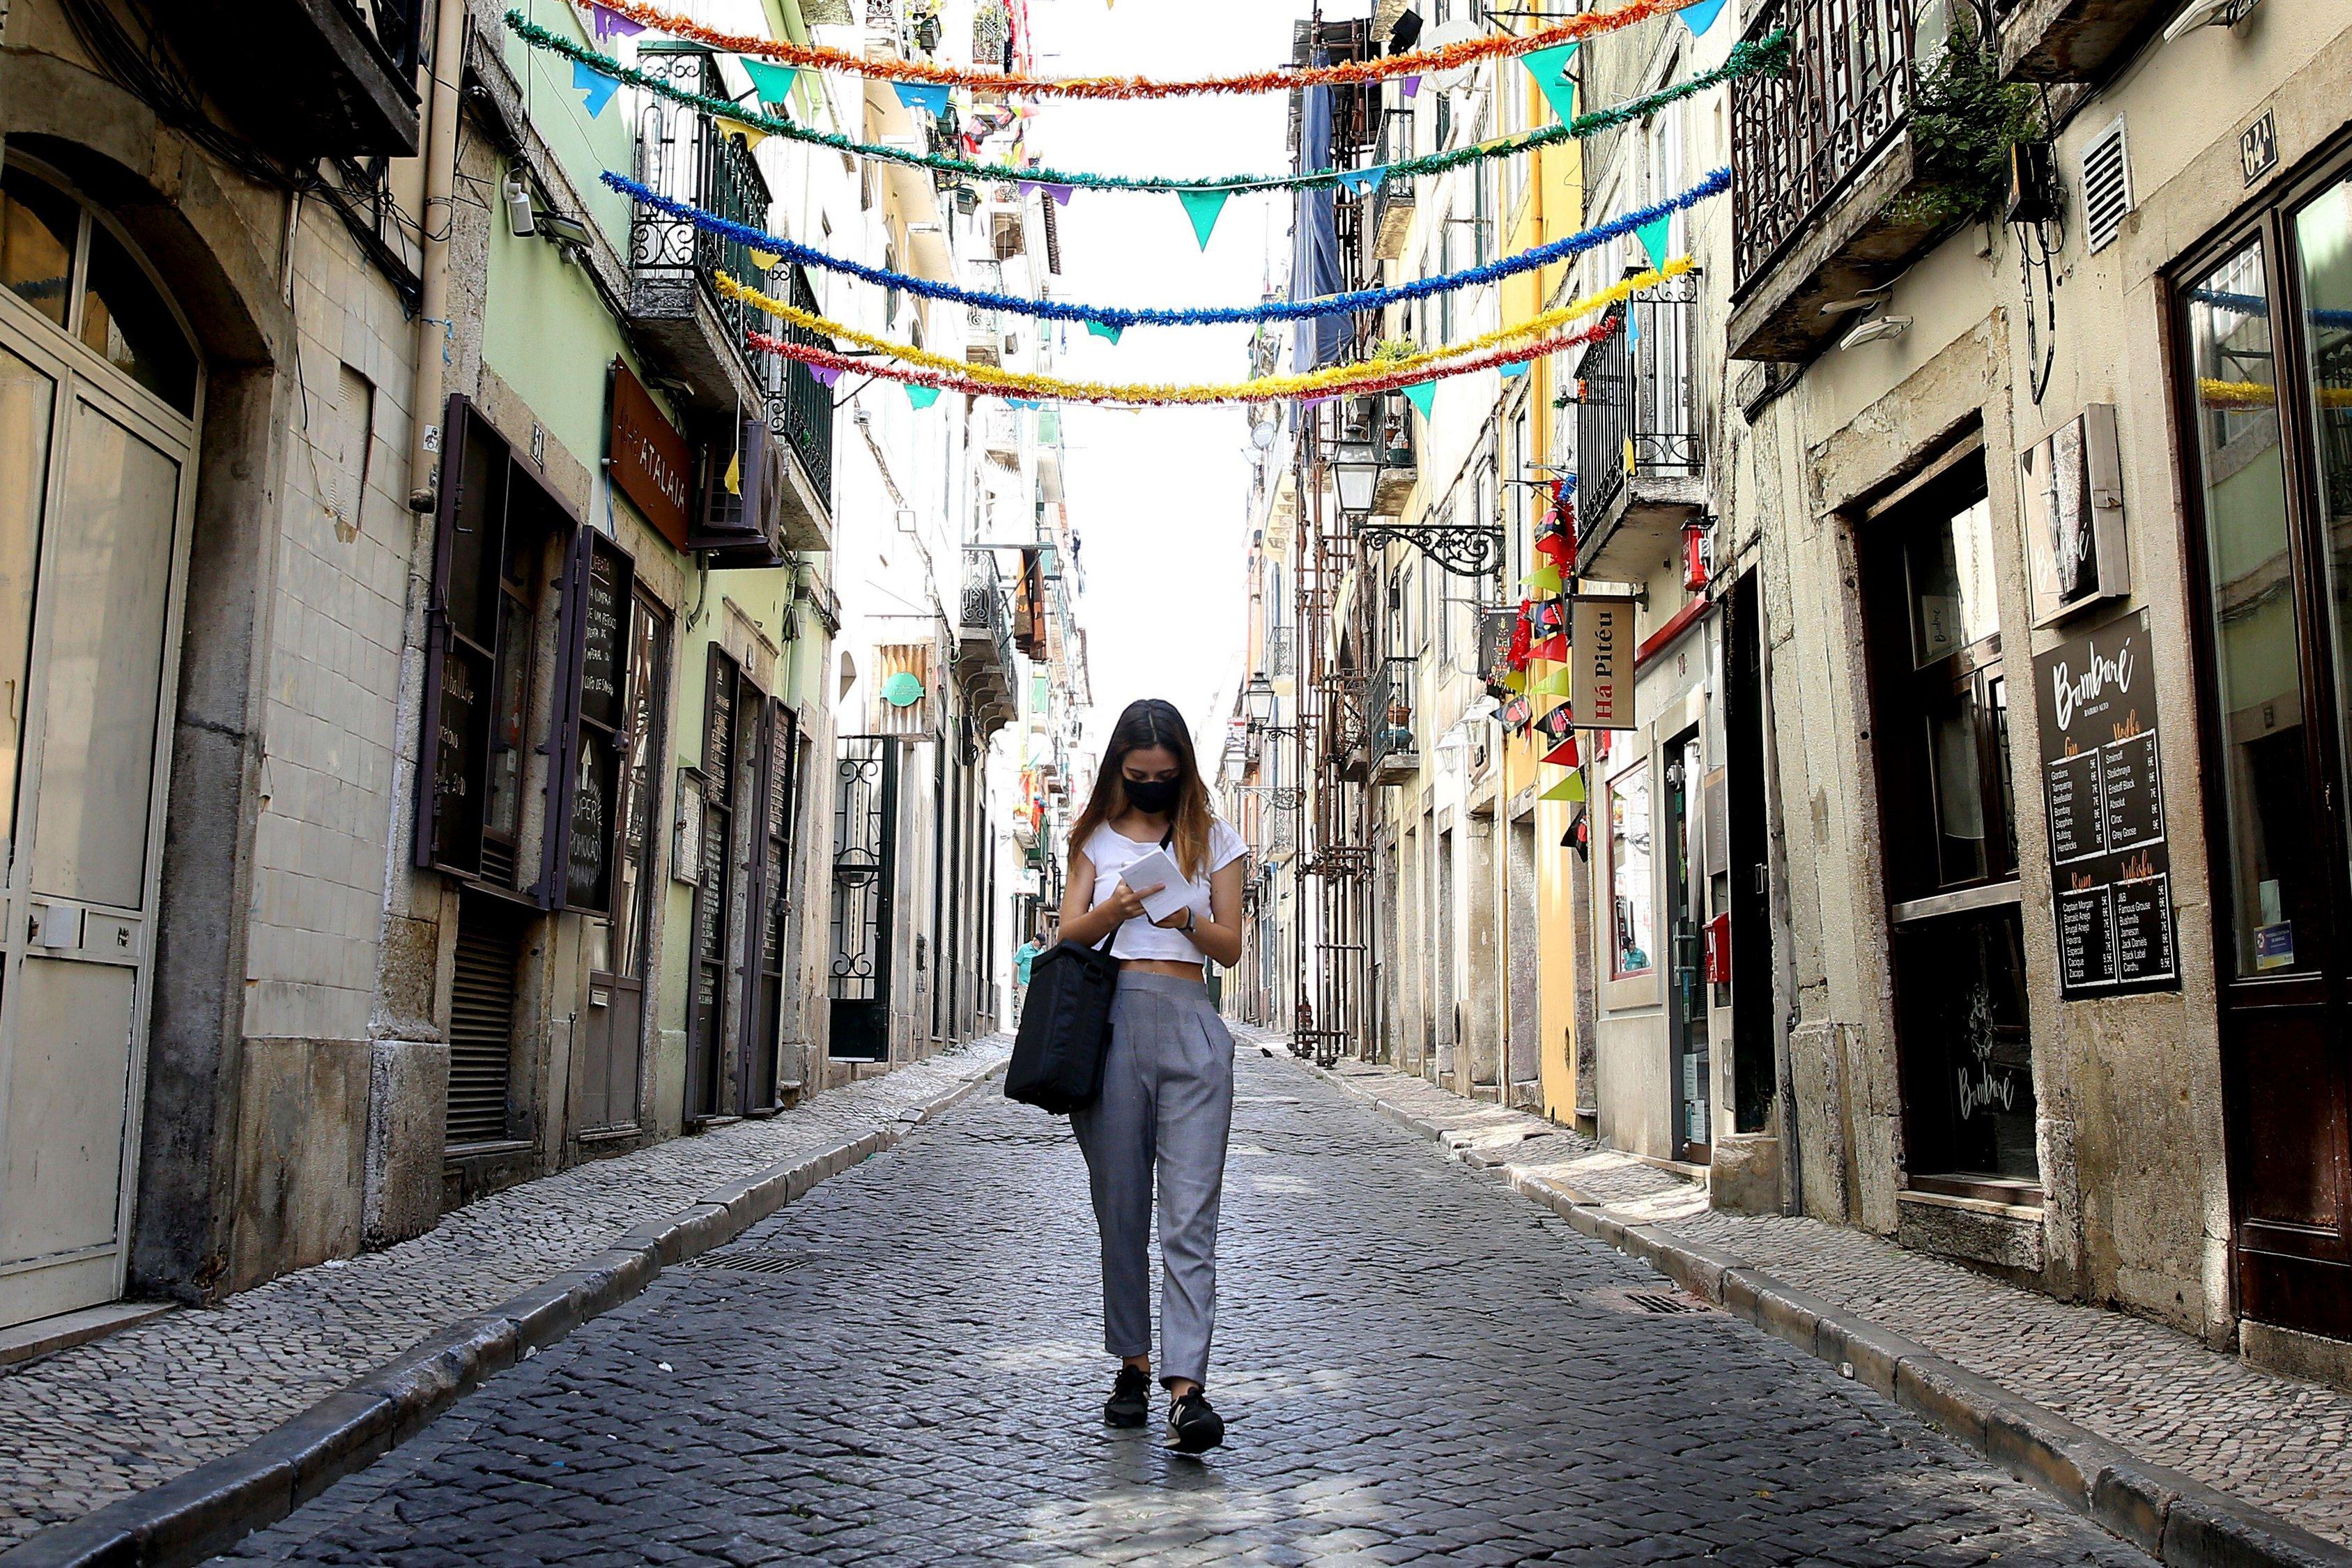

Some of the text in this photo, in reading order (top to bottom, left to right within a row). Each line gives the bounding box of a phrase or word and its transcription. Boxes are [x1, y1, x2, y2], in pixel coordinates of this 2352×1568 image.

[534, 426, 543, 460] 51
[640, 438, 684, 514] ATALAIA
[1594, 611, 1613, 720] Há Pitéu
[2053, 636, 2134, 731] Bambaré
[2113, 709, 2140, 746] Vodka
[2065, 737, 2078, 760] Gin
[2051, 769, 2068, 781] Gordons
[2107, 766, 2131, 779] Stolichnaya
[2052, 780, 2073, 793] Tanqueray
[2108, 783, 2123, 794] Eristoff
[2123, 780, 2135, 790] Black
[2053, 792, 2073, 804] Beefeater
[2109, 798, 2126, 810] Absolut
[2054, 806, 2071, 817] Bombay
[2055, 817, 2073, 829] Sapphire
[2057, 830, 2071, 841] Bulldog
[2112, 831, 2123, 840] Grey
[2123, 827, 2137, 837] Goose
[2057, 842, 2077, 852] Hendricks
[2121, 850, 2154, 887] Whisky
[2072, 872, 2092, 893] Rum
[2117, 893, 2126, 902] J&B
[2063, 902, 2078, 912] Captain
[2078, 898, 2094, 911] Morgan
[2119, 903, 2135, 914] Famous
[2135, 900, 2151, 912] Grouse
[2119, 914, 2139, 926] Bushmills
[2065, 924, 2078, 935] Brugal
[2120, 926, 2139, 937] Jameson
[2066, 935, 2081, 945] Havana
[2121, 940, 2131, 949] Jack
[2131, 937, 2147, 948] Daniels
[2067, 946, 2084, 956] Especial
[2123, 951, 2134, 960] Black
[2135, 949, 2146, 959] Label
[2068, 957, 2084, 967] Cacique
[2123, 962, 2139, 972] Cardhu
[2069, 968, 2084, 978] Zacapa
[1958, 1061, 2014, 1120] Bambaré
